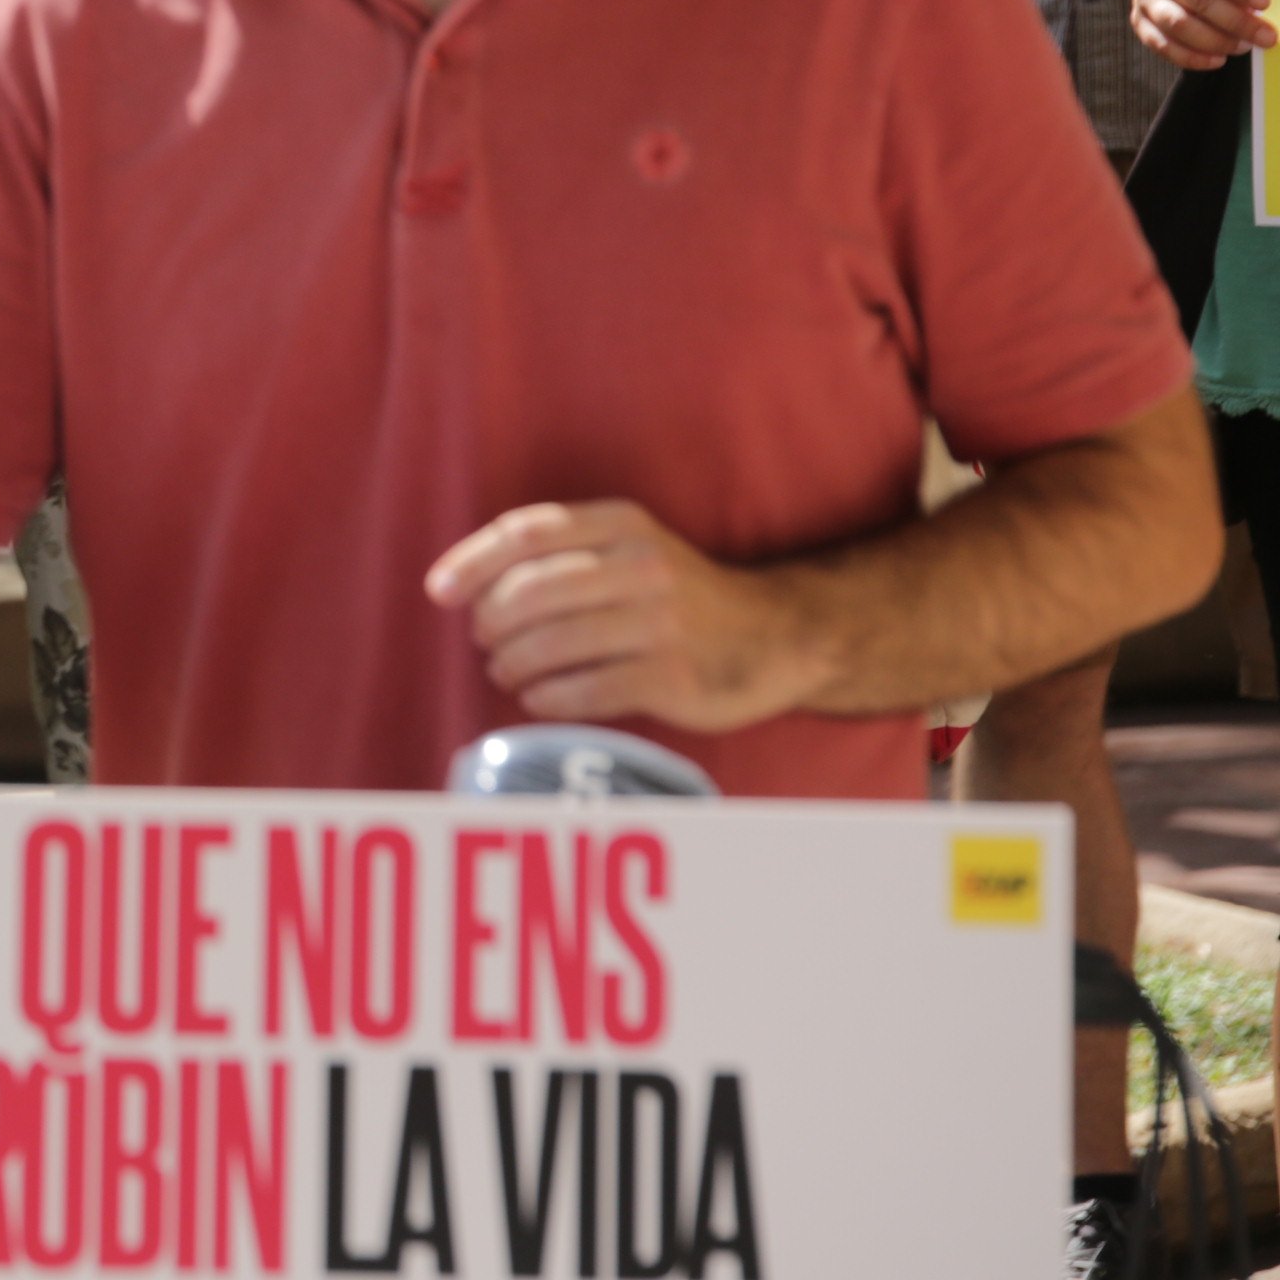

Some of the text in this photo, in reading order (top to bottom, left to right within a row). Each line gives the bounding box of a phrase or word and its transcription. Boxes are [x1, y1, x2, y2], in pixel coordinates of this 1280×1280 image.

[20, 820, 670, 1058] QUE NO ENS
[322, 1061, 458, 1278] LA
[490, 1066, 762, 1280] VIDA
